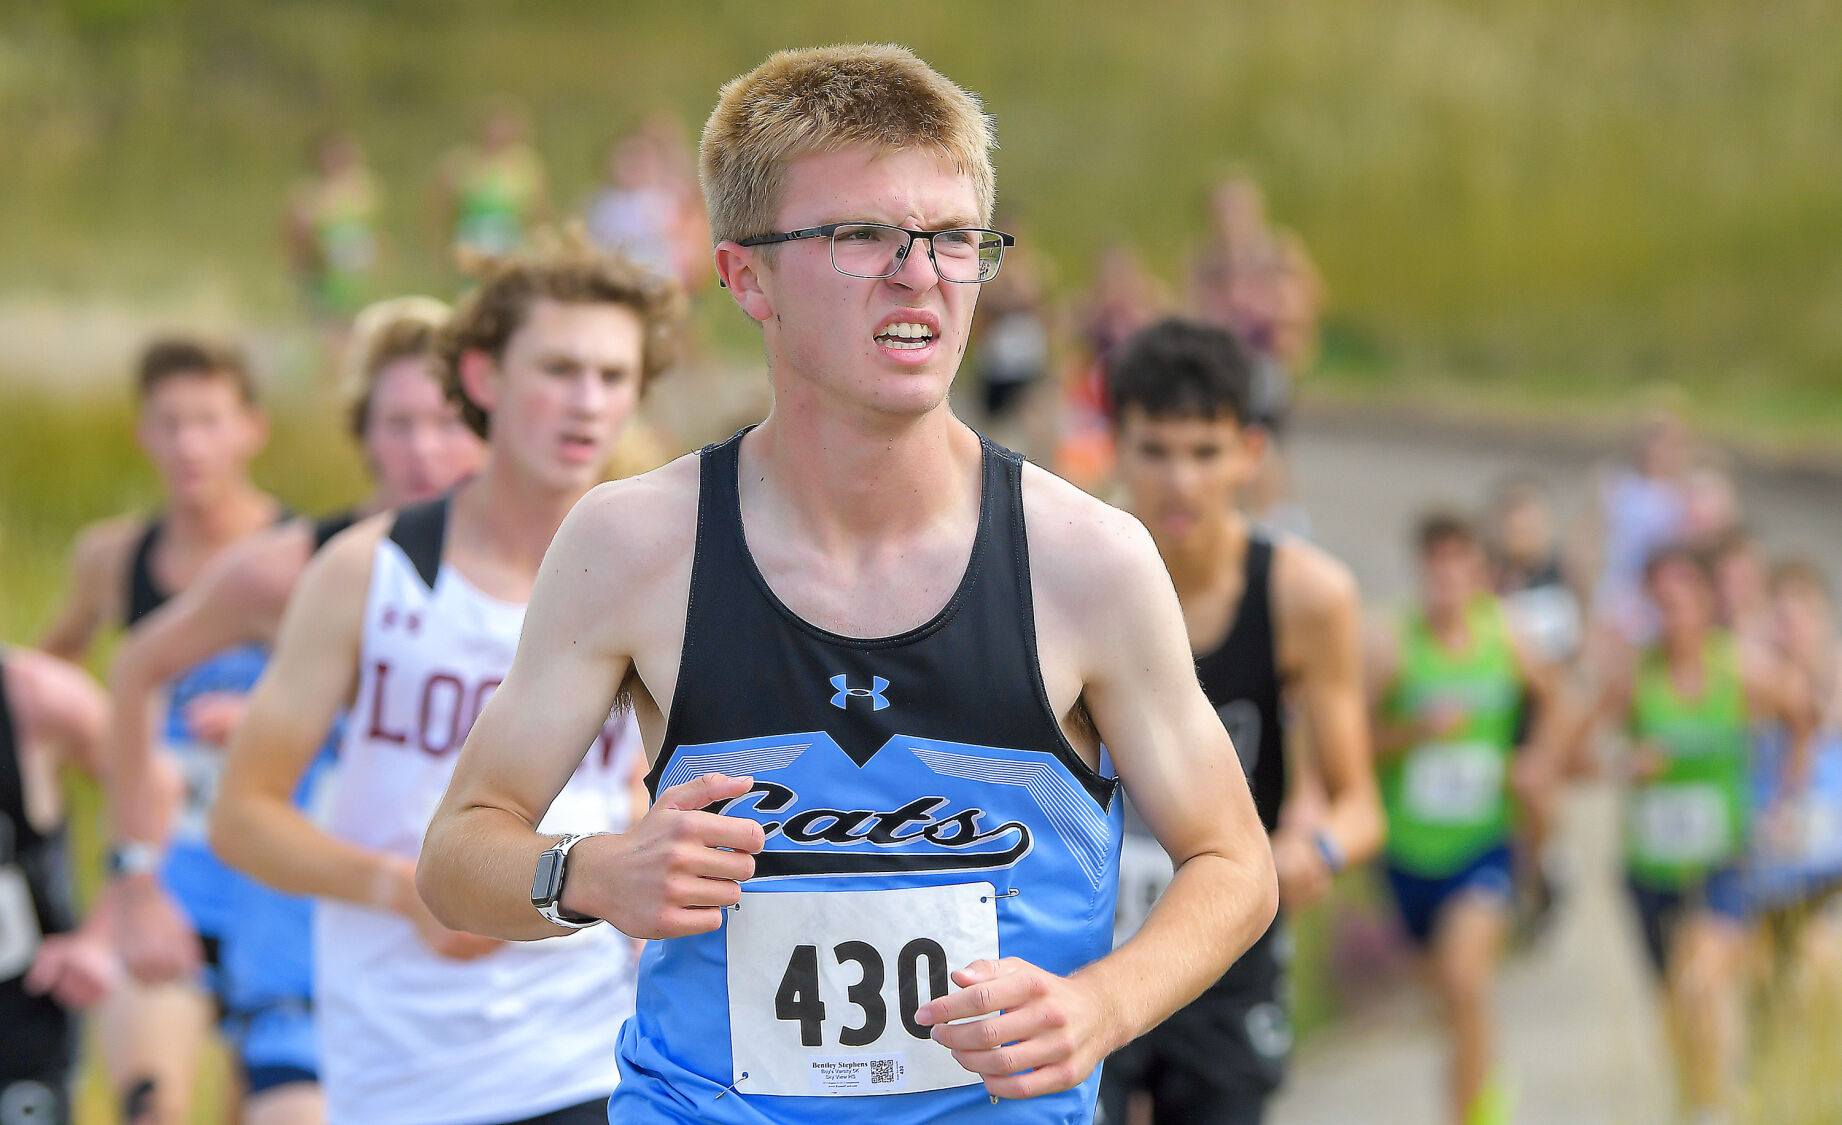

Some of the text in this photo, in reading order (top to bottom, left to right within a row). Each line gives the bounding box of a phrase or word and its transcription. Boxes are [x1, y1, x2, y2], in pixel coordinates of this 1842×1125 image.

[700, 778, 986, 849] Cats
[774, 937, 949, 1047] 430
[838, 1061, 868, 1069] Stephens
